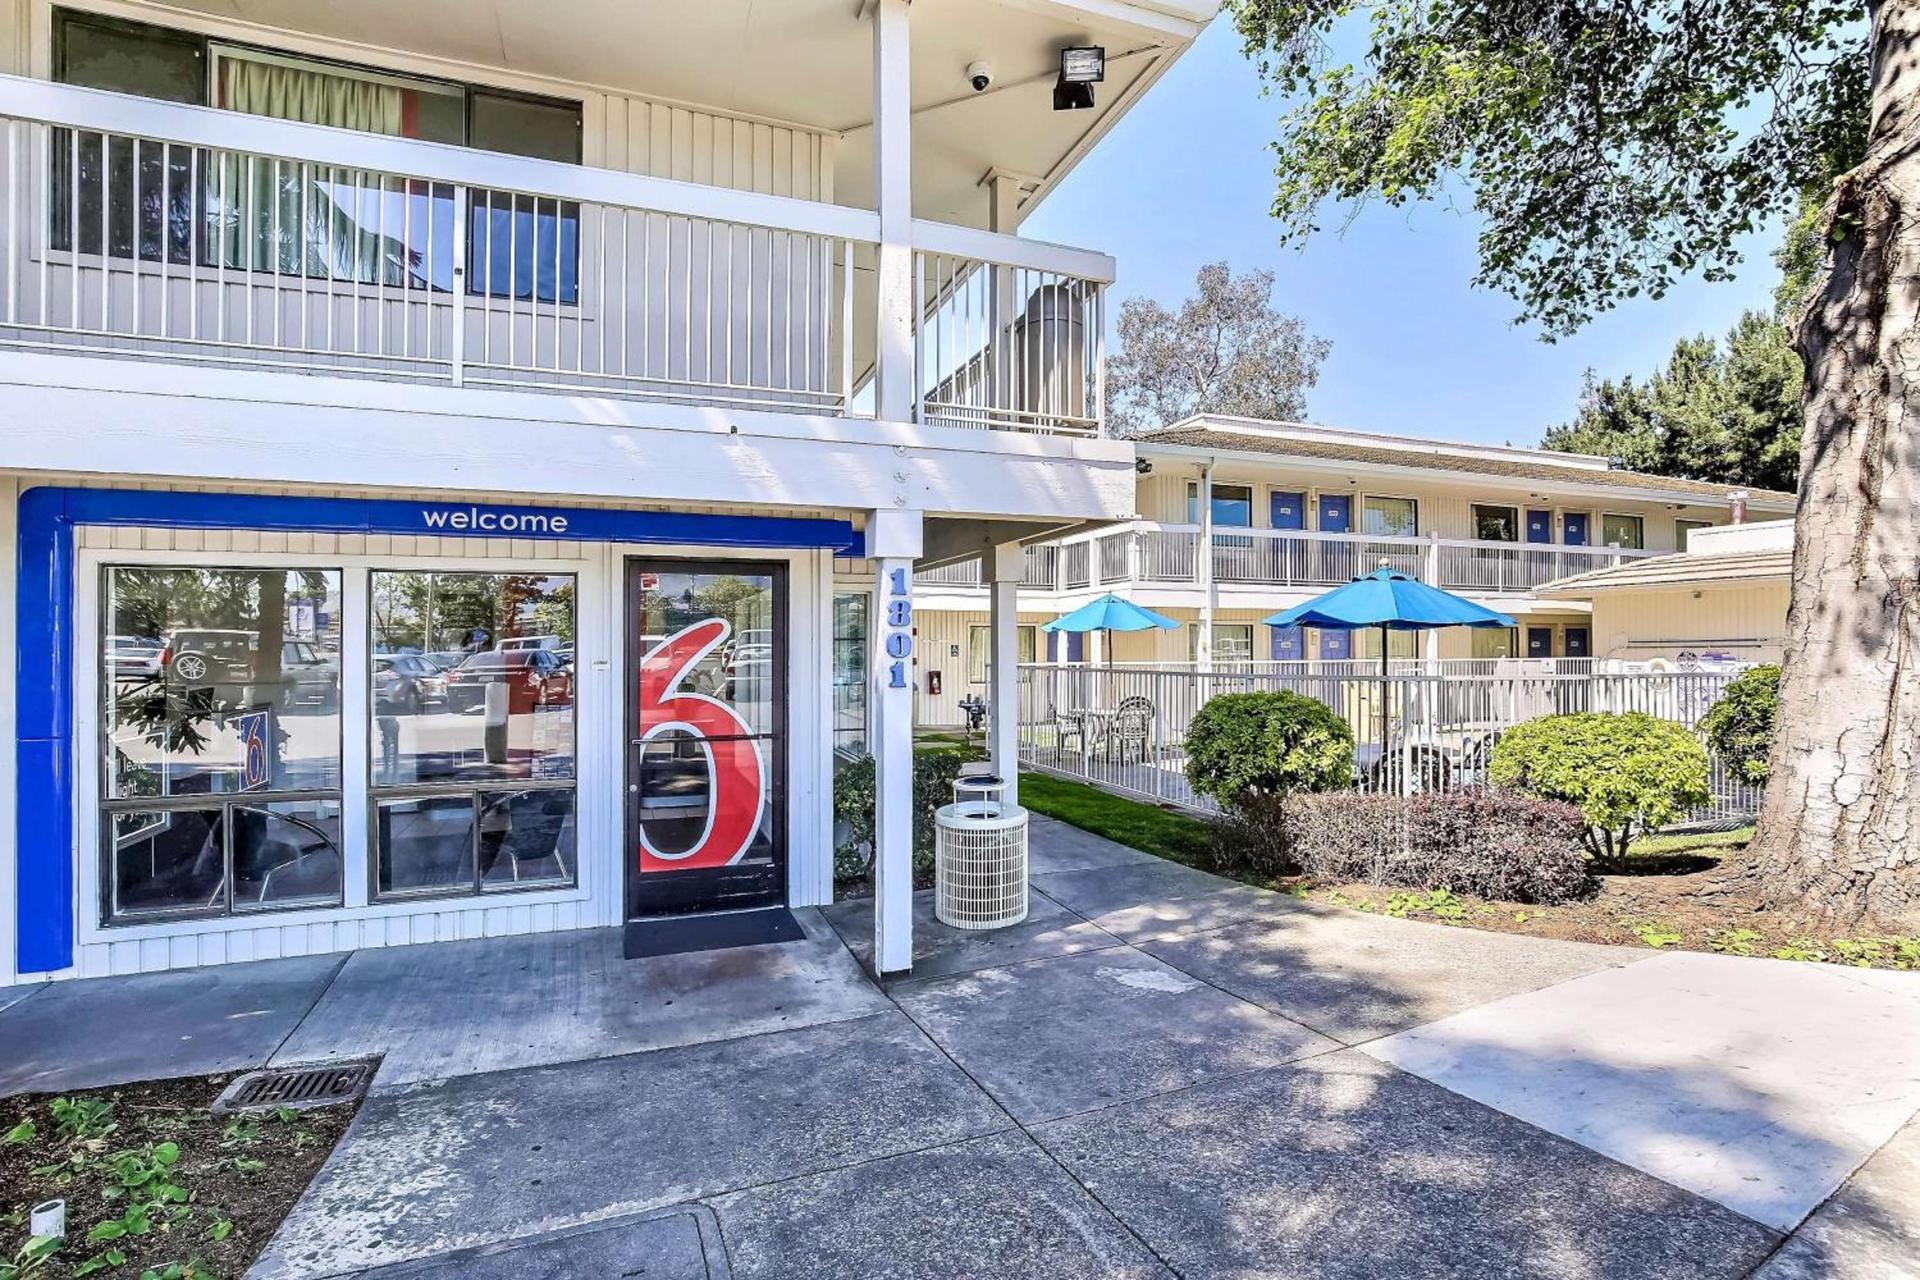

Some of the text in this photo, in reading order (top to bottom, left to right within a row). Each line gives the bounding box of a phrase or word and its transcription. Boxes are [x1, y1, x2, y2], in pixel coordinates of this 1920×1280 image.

[422, 507, 568, 532] welcome
[887, 568, 912, 688] 1801
[246, 716, 264, 787] 6
[640, 617, 766, 873] 6
